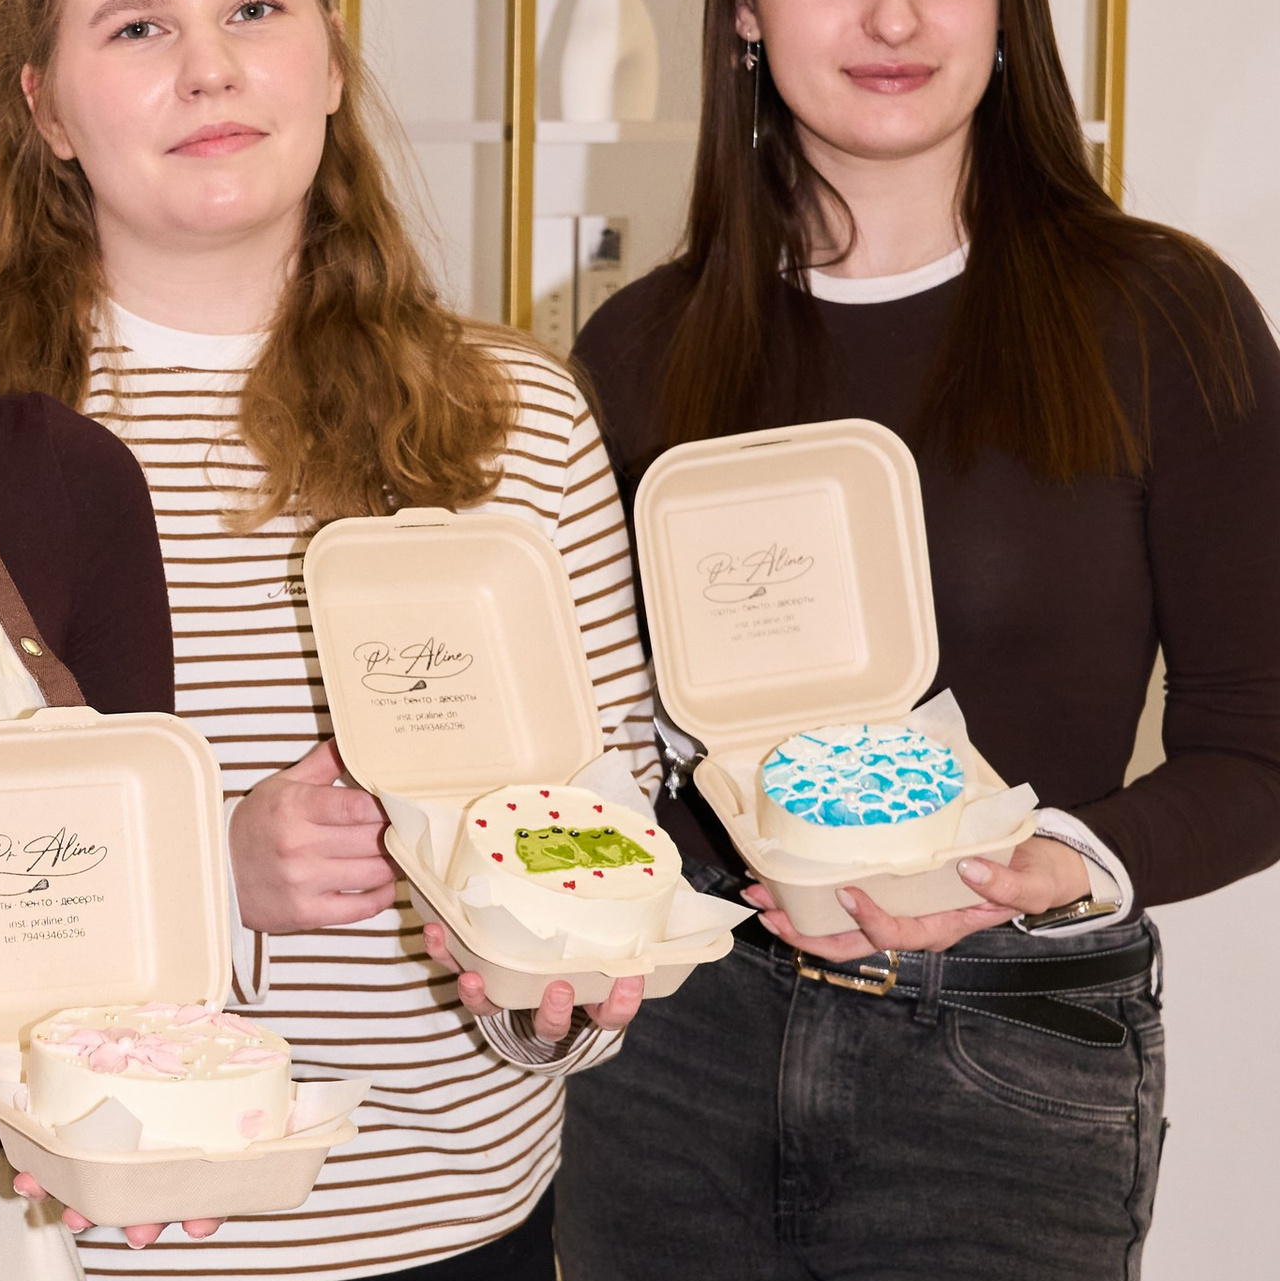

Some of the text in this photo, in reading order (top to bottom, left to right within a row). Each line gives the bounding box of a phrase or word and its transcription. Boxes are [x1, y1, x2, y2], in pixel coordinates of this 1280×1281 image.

[399, 636, 474, 675] Aline
[23, 826, 108, 873] Aline
[19, 898, 53, 909] бенто
[60, 894, 105, 907] десерты
[22, 927, 87, 942] 79493465296
